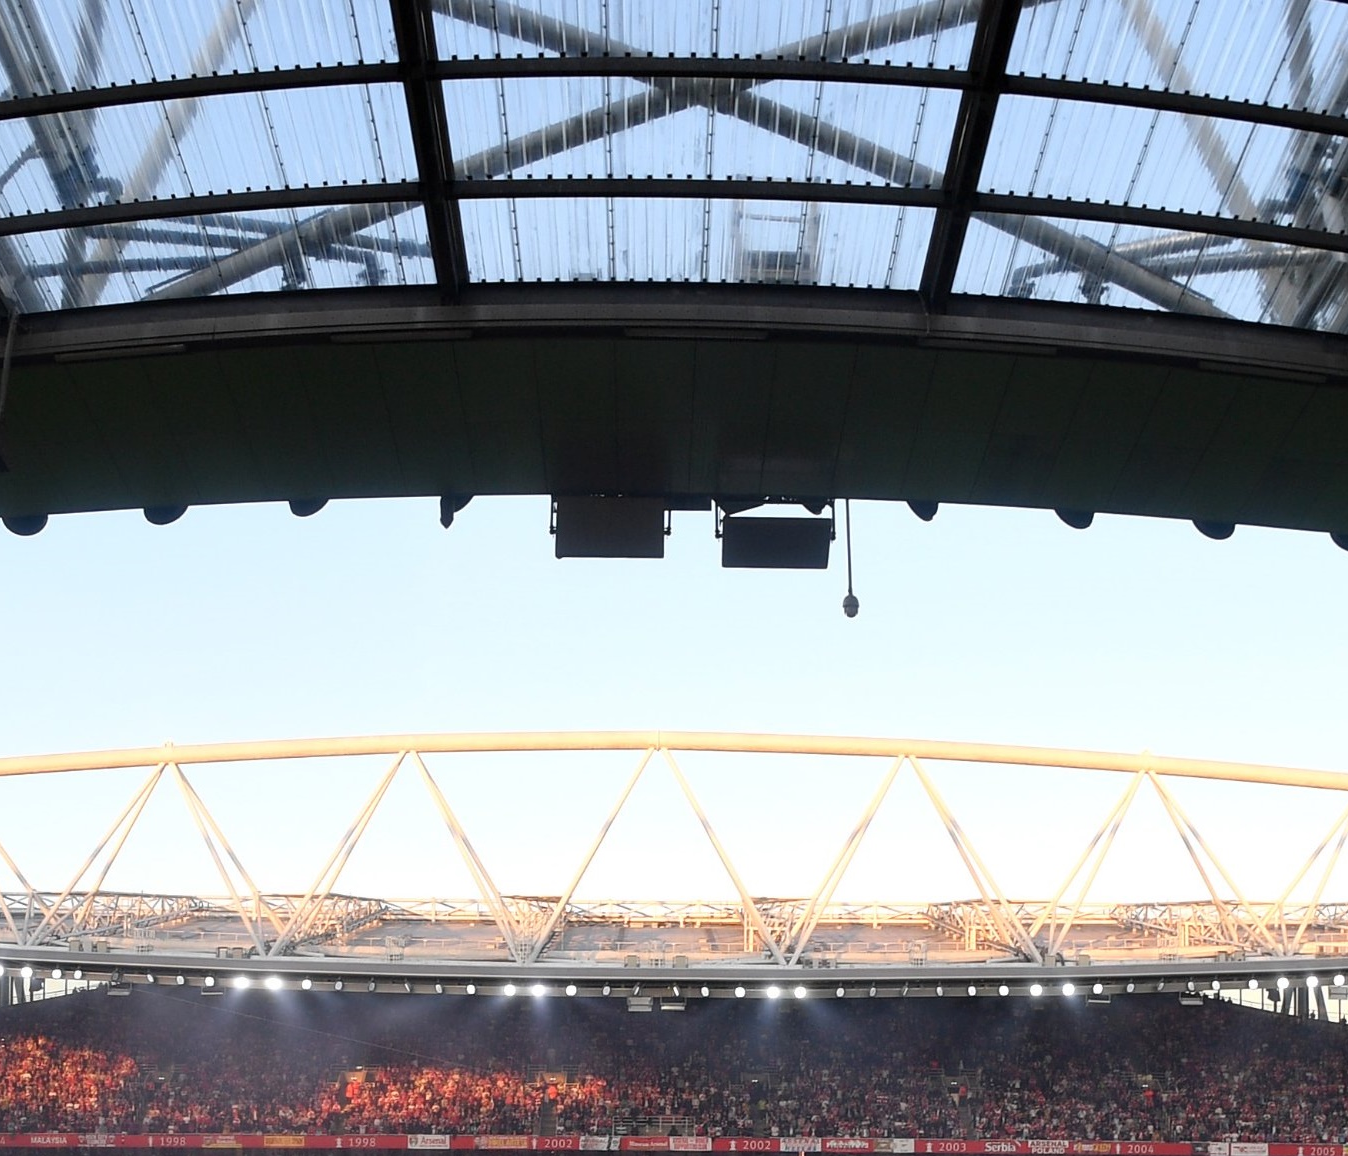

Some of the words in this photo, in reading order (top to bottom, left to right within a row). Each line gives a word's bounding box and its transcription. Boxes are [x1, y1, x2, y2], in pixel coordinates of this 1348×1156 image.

[31, 1136, 67, 1144] MALAYSIA
[160, 1137, 186, 1146] 1998
[349, 1138, 376, 1147] 1998
[420, 1136, 449, 1146] Arsenal
[544, 1138, 573, 1148] 2002
[743, 1140, 771, 1150] 2002
[939, 1142, 967, 1152] 2003
[984, 1142, 1017, 1152] Serbia
[1127, 1144, 1154, 1154] 2004
[1311, 1147, 1335, 1156] 2005
